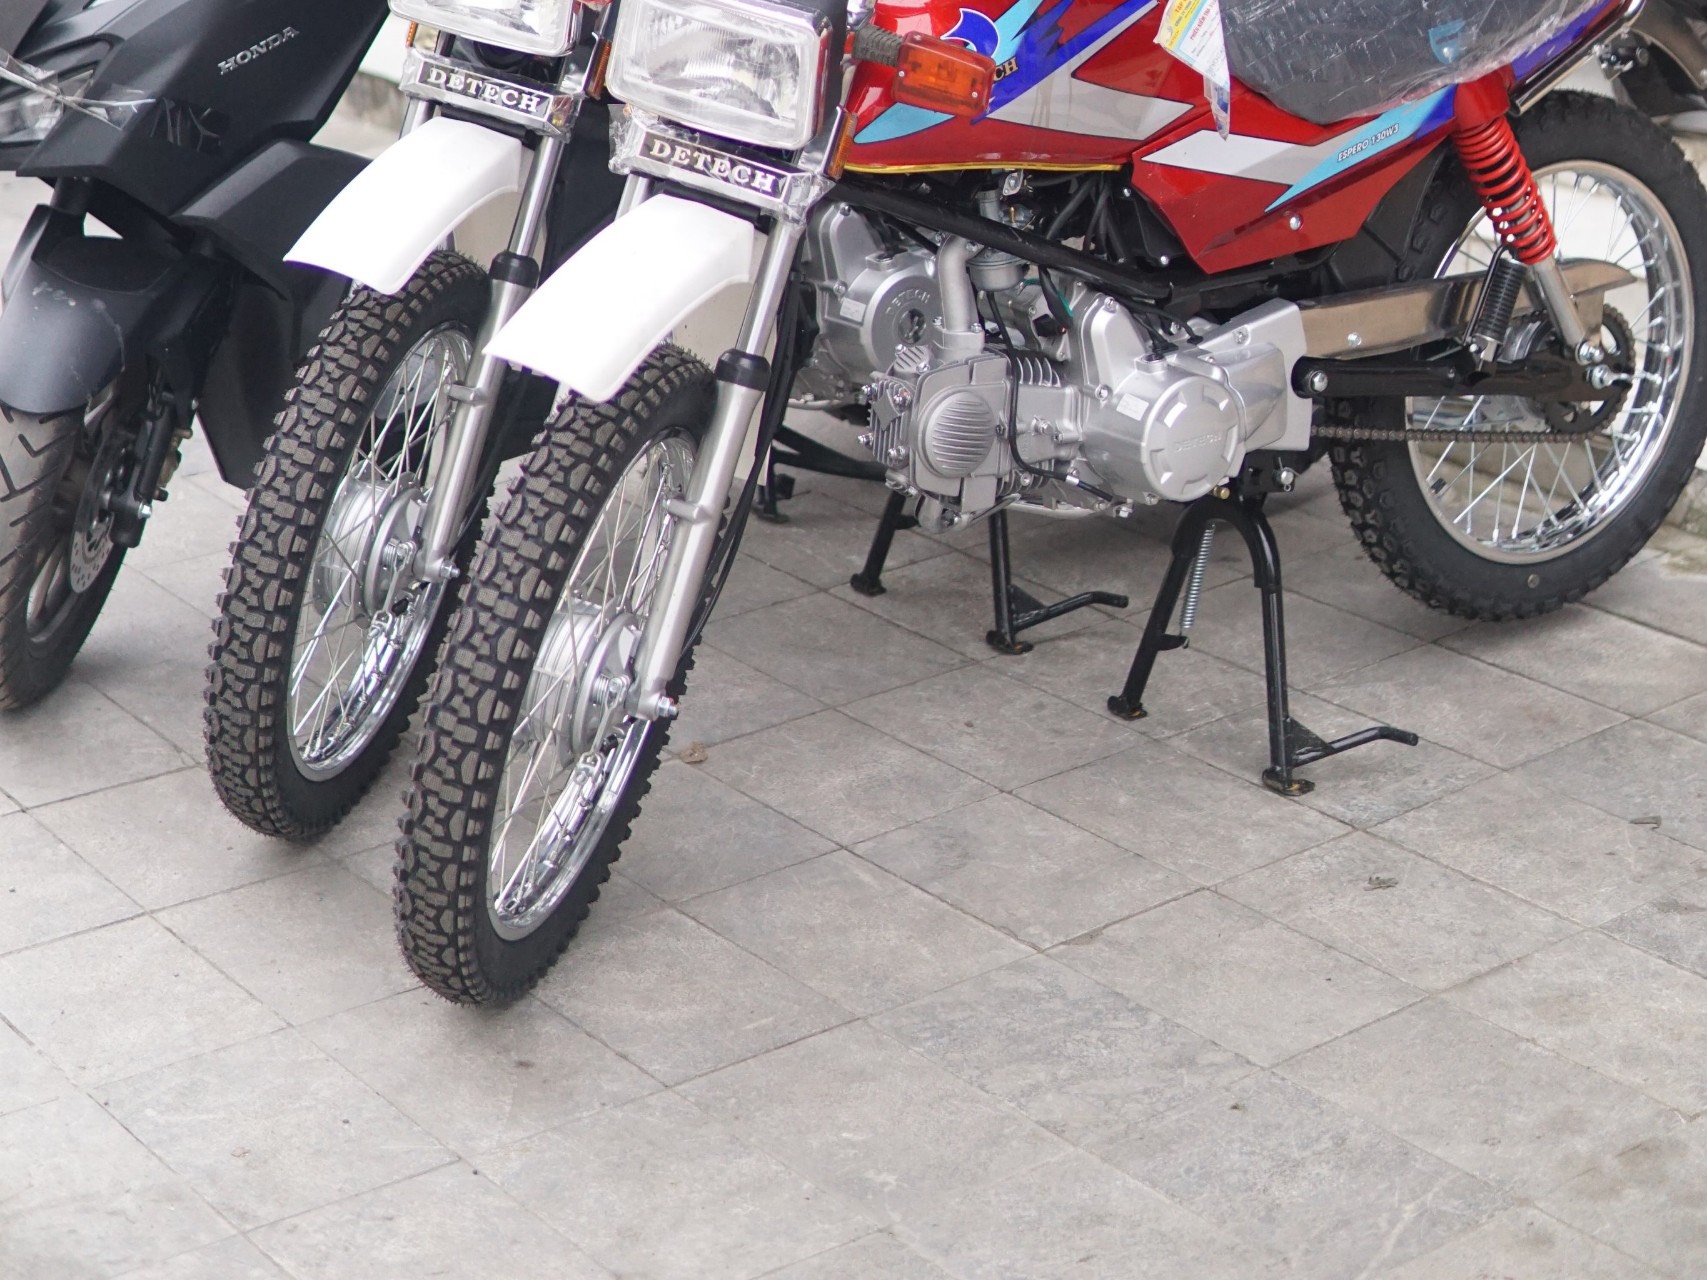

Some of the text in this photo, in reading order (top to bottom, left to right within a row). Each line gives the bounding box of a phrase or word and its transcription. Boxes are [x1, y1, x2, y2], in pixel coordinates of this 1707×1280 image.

[218, 26, 300, 75] HONDA
[427, 67, 541, 113] DETECH
[649, 138, 776, 193] DETECH
[1337, 139, 1369, 162] ESPERO
